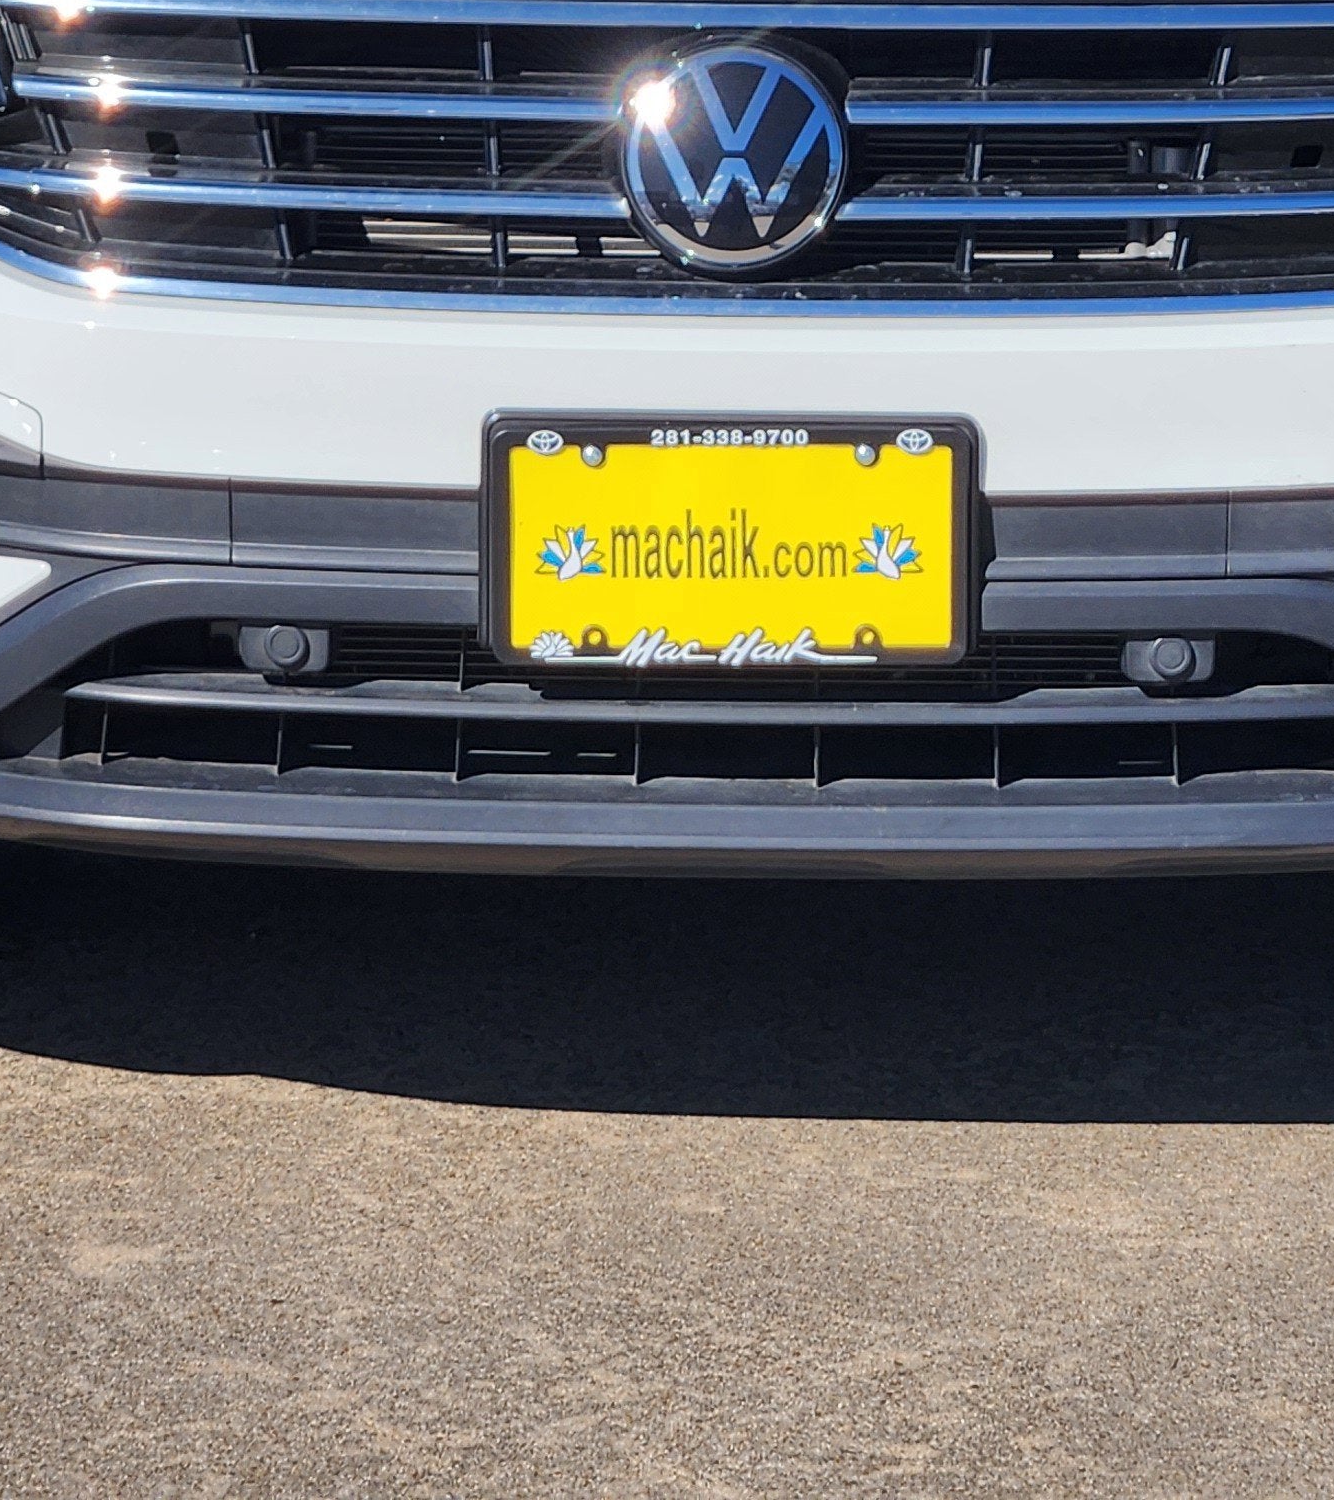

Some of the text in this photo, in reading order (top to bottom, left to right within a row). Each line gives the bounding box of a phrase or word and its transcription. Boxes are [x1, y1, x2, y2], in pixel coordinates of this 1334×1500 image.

[650, 428, 810, 447] 281-338-9700
[610, 507, 848, 579] machaik.com
[616, 626, 827, 669] Mac Haik
